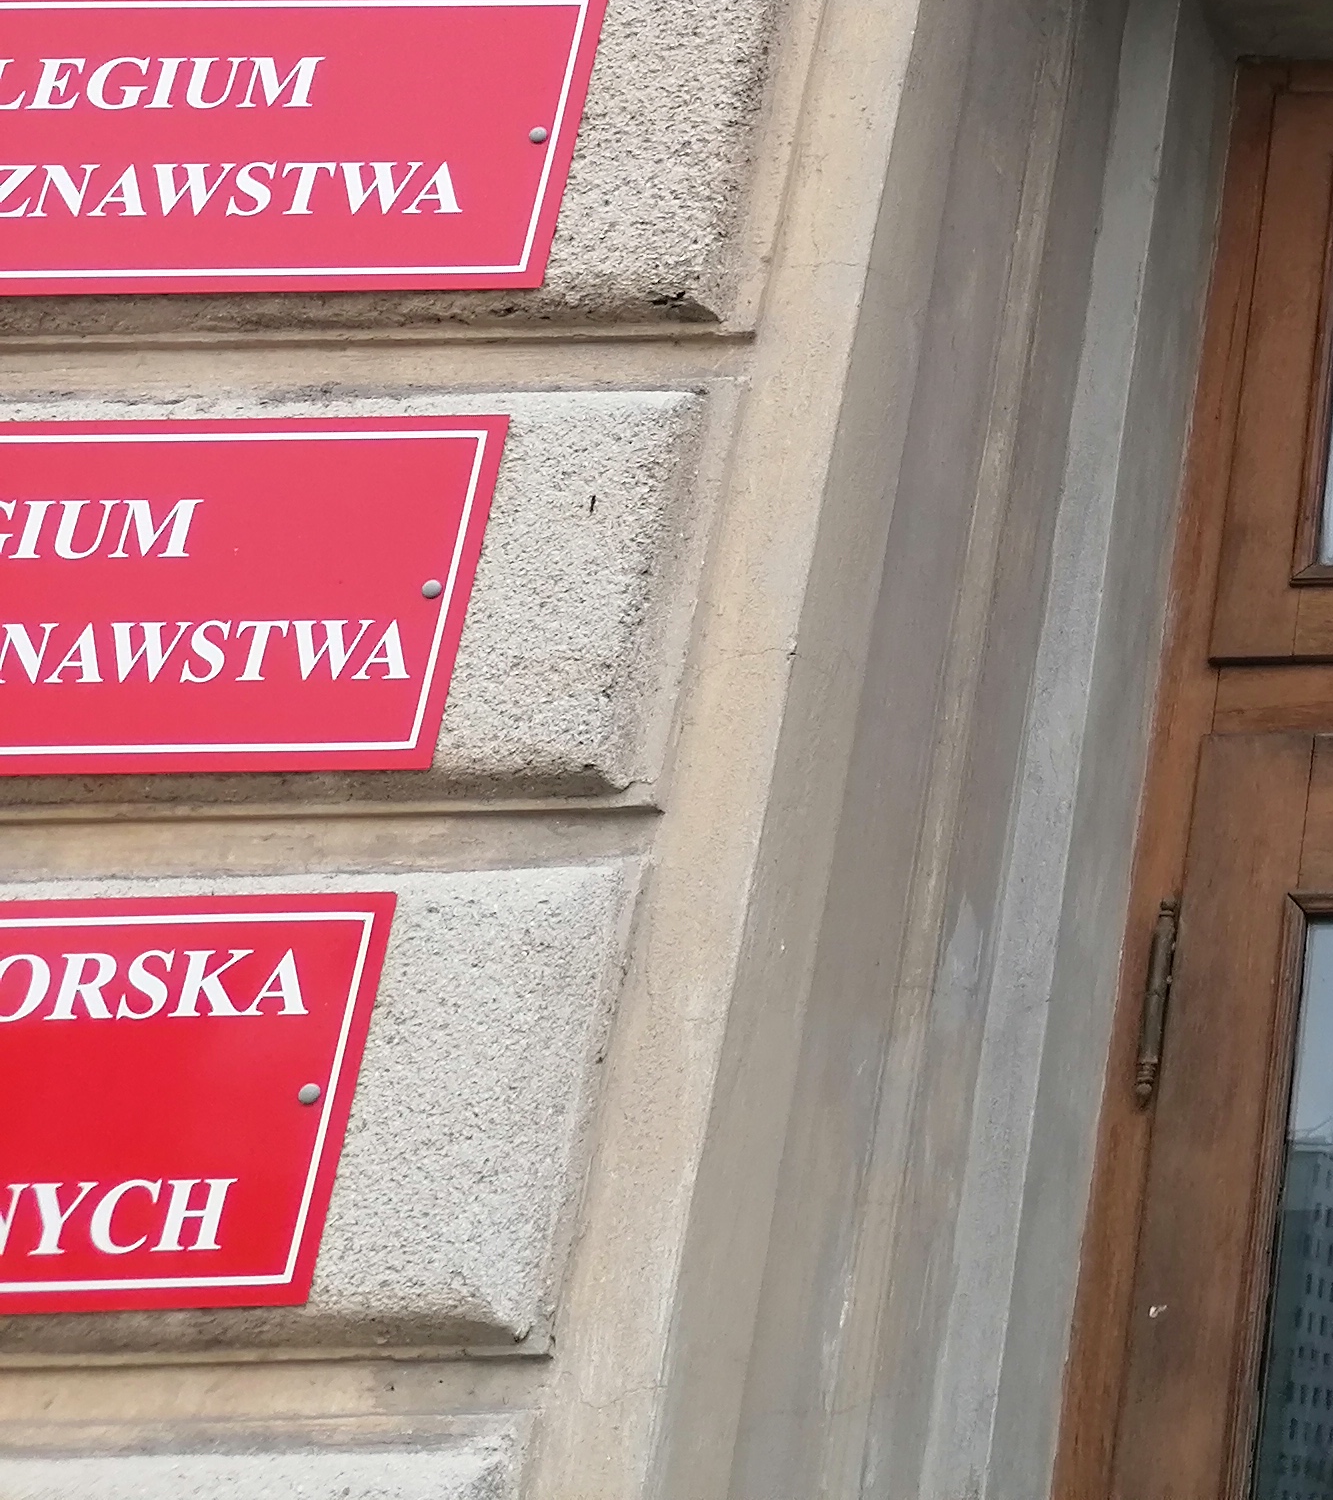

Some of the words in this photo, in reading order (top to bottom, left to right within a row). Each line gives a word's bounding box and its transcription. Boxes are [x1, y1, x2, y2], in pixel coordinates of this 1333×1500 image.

[0, 499, 204, 560] IUM
[0, 619, 411, 684] NAWSTWA
[0, 948, 309, 1023] ORSKA
